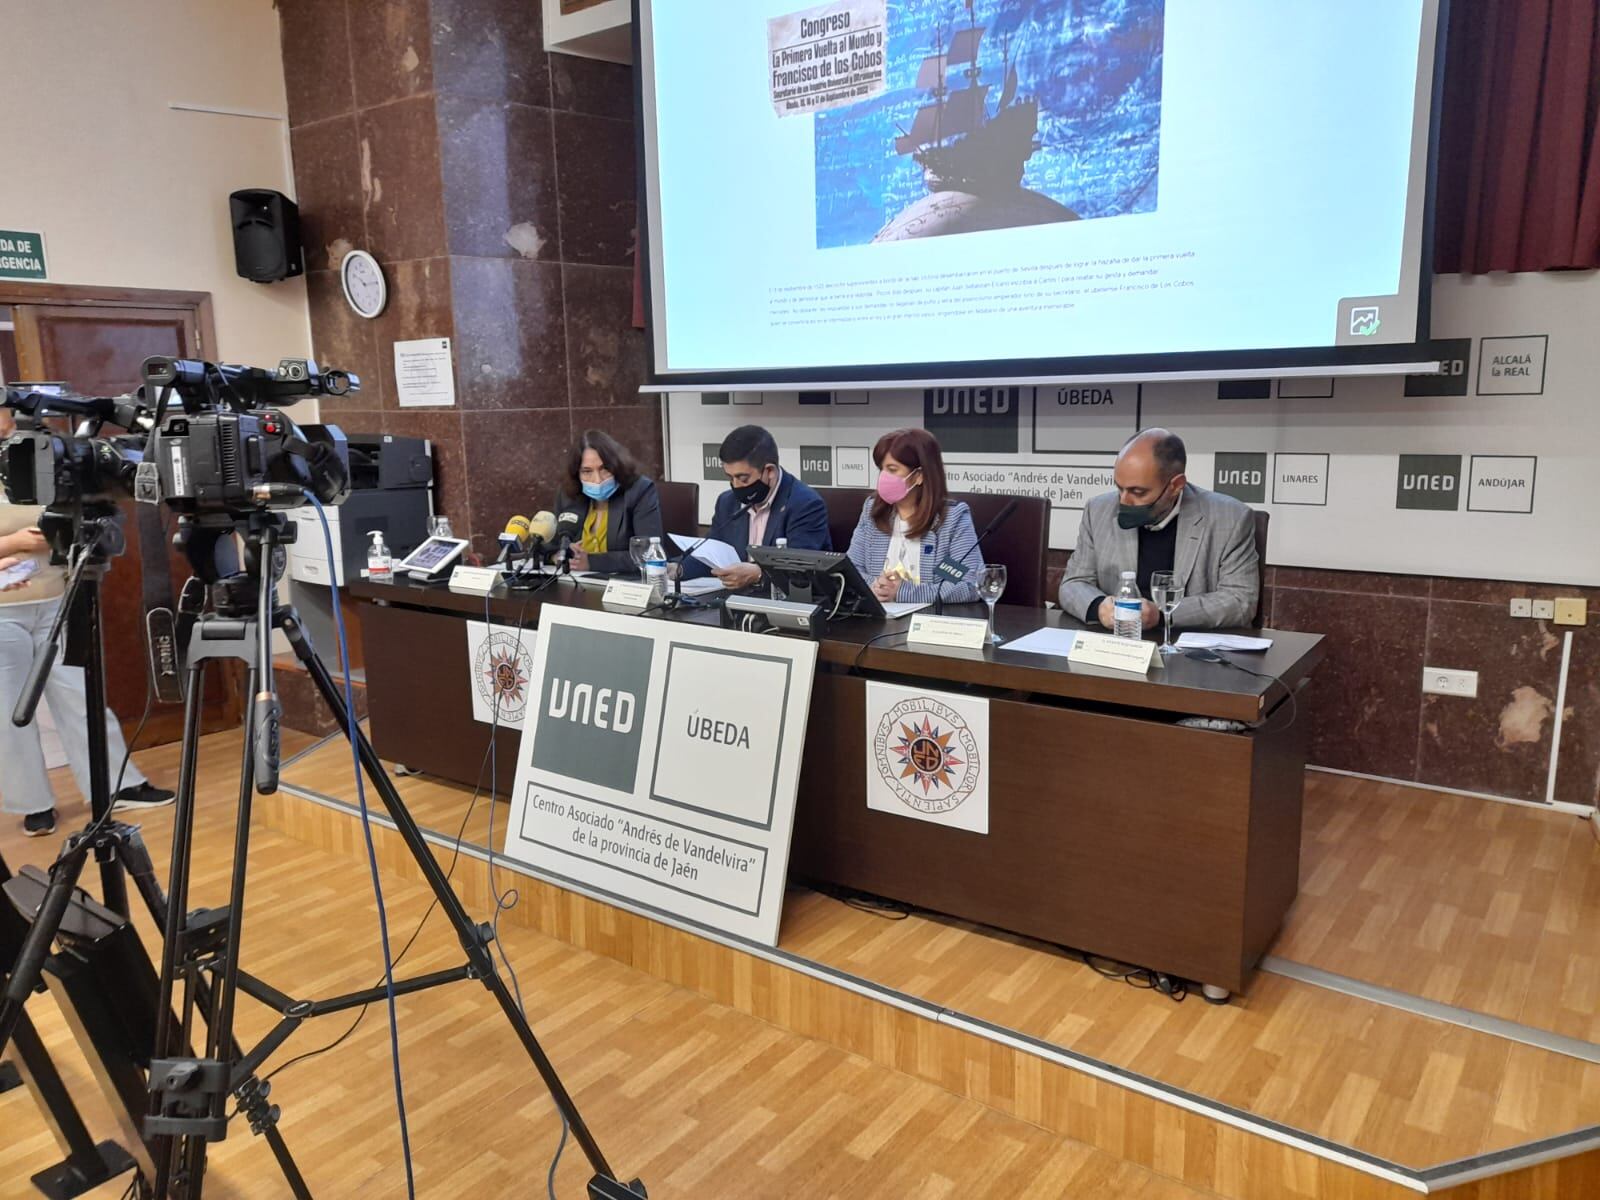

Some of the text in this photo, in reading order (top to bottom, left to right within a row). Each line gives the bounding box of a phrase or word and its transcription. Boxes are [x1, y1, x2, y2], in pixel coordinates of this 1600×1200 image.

[800, 11, 850, 39] Congreso
[772, 31, 882, 68] La Primera Vuelta al Mundo y
[773, 50, 882, 88] Francisco de los Cobos
[17, 240, 32, 253] DE
[0, 256, 42, 271] GENCIA
[1492, 354, 1532, 366] ALCALÁ
[1491, 367, 1530, 377] la REAL
[932, 387, 1010, 414] UNED
[1057, 388, 1114, 406] ÚBEDA
[705, 456, 723, 468] UNE
[802, 459, 830, 472] UNED
[842, 463, 864, 471] LINARES
[947, 472, 960, 481] tro
[962, 472, 1006, 482] Asociado
[1051, 474, 1064, 484] de
[1067, 474, 1116, 486] Vandelvi
[1218, 470, 1262, 485] UNED
[1282, 474, 1318, 484] LINARES
[1403, 474, 1454, 491] UNED
[1478, 477, 1526, 490] ANDÚJAR
[996, 487, 1040, 498] provincia
[1044, 486, 1056, 499] de
[1060, 488, 1082, 501] Jaén
[939, 562, 964, 578] UNED
[548, 678, 636, 734] UNED
[894, 699, 958, 724] MOBILIBVS
[687, 709, 750, 750] ÚBEDA
[533, 794, 564, 816] Centro
[567, 805, 614, 831] Asociado
[664, 833, 680, 852] de
[572, 828, 698, 880] de la provincia de Jaén
